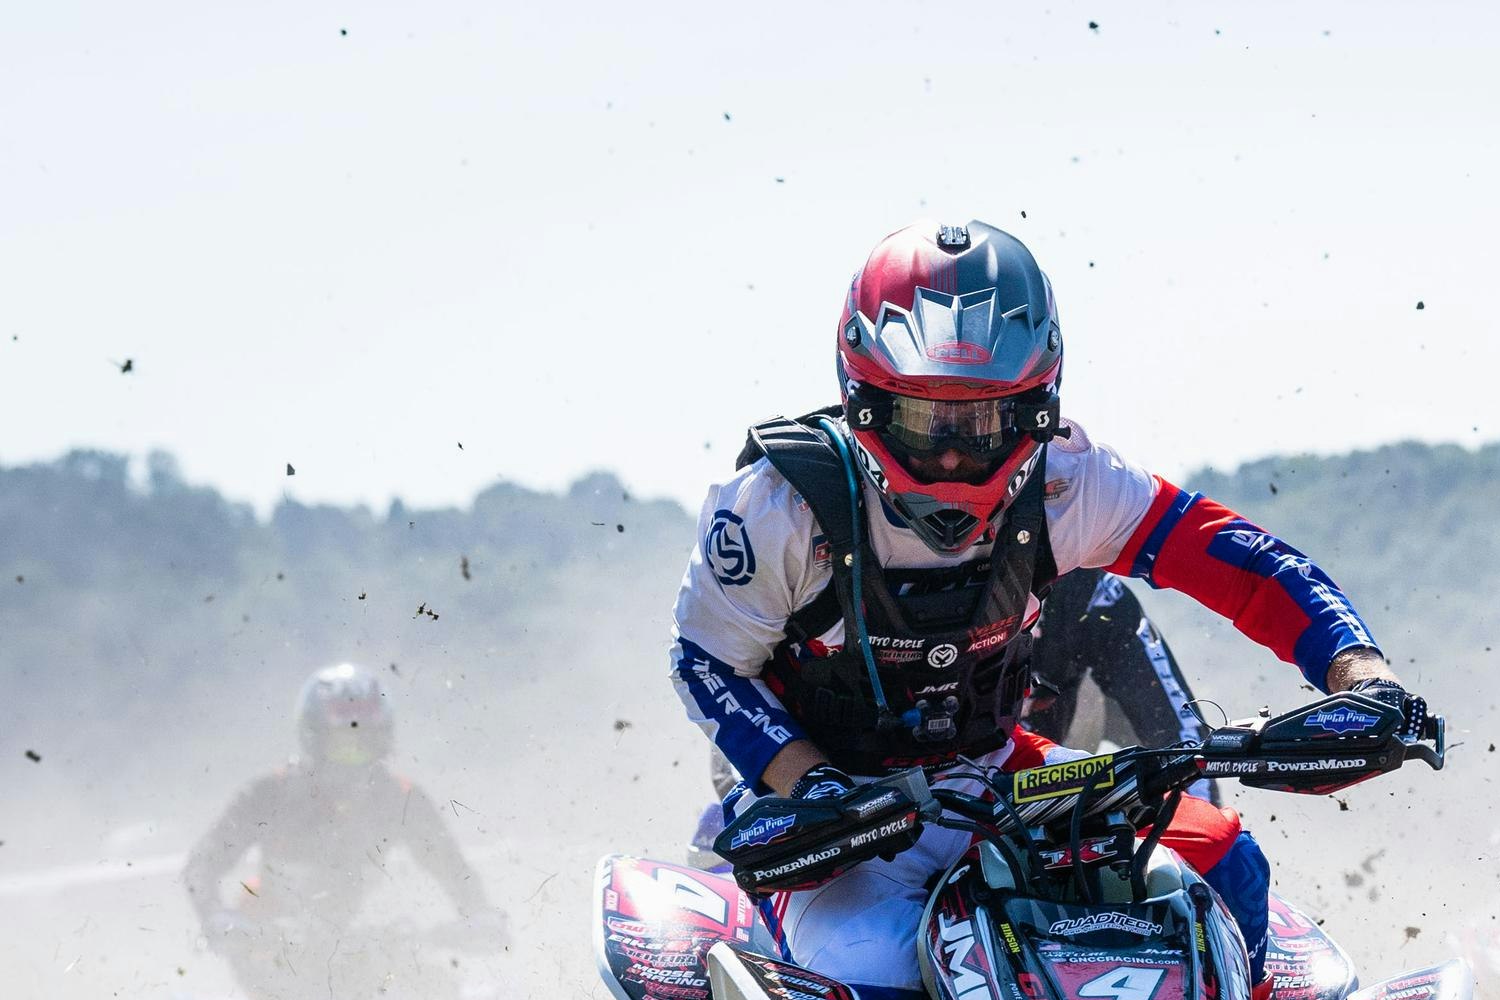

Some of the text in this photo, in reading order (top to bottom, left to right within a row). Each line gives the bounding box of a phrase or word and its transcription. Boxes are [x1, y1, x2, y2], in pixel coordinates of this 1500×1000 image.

[1206, 761, 1259, 773] MATTO CYCLE
[851, 818, 908, 849] MATTO CYCLE
[1049, 911, 1163, 935] QUADTECH
[632, 963, 696, 978] MOOSE
[640, 972, 707, 987] RACING
